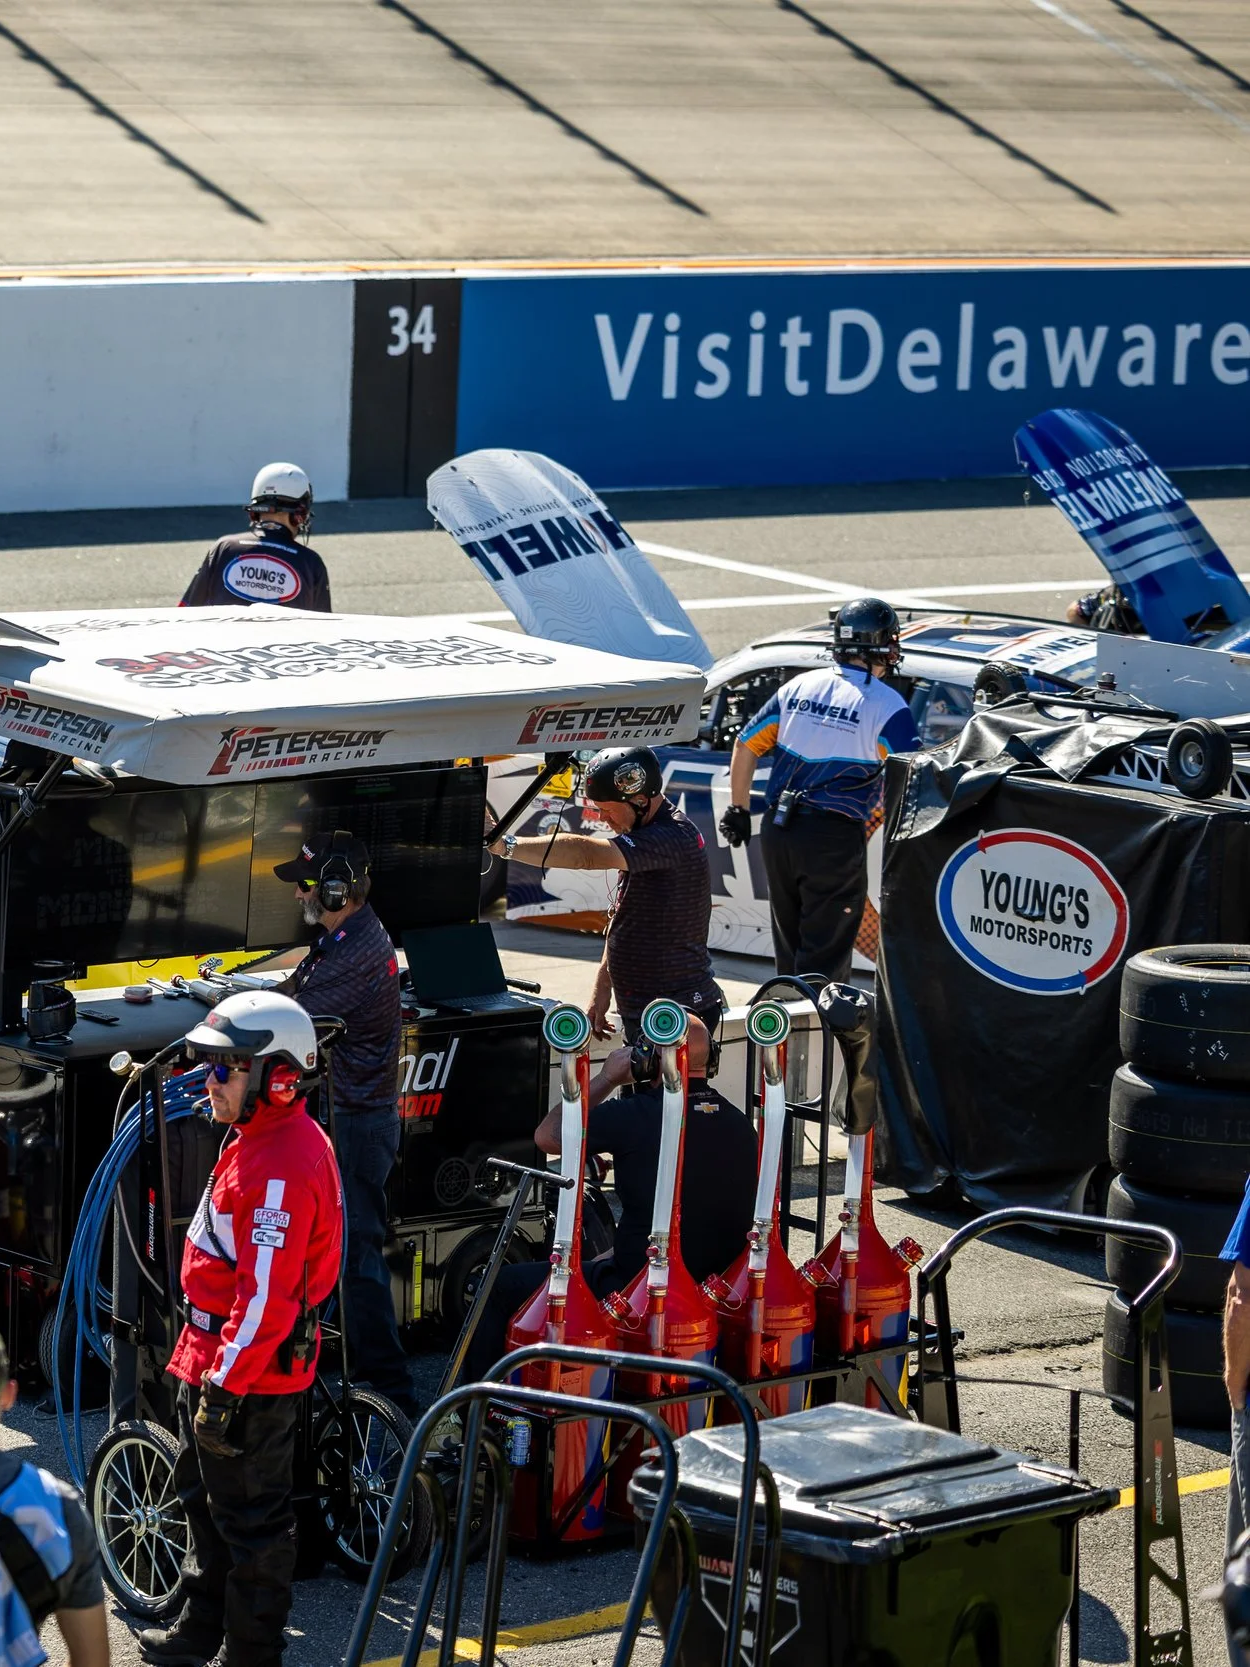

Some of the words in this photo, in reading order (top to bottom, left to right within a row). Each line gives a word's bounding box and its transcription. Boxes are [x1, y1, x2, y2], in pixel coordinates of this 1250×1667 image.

[386, 305, 437, 357] 34
[594, 302, 1250, 401] VisitDelaware
[235, 580, 285, 595] MOTORSPORTS
[239, 566, 287, 585] YOUNG'S
[1, 700, 116, 744] PETERSON
[536, 703, 686, 732] PETERSON
[787, 698, 861, 724] HOWELL
[50, 731, 103, 755] RACING
[230, 730, 395, 762] PETERSON
[610, 728, 674, 739] RACING
[309, 748, 376, 764] RACING
[979, 868, 1091, 930] YOUNG'S
[969, 914, 1094, 957] MOTORSPORTS
